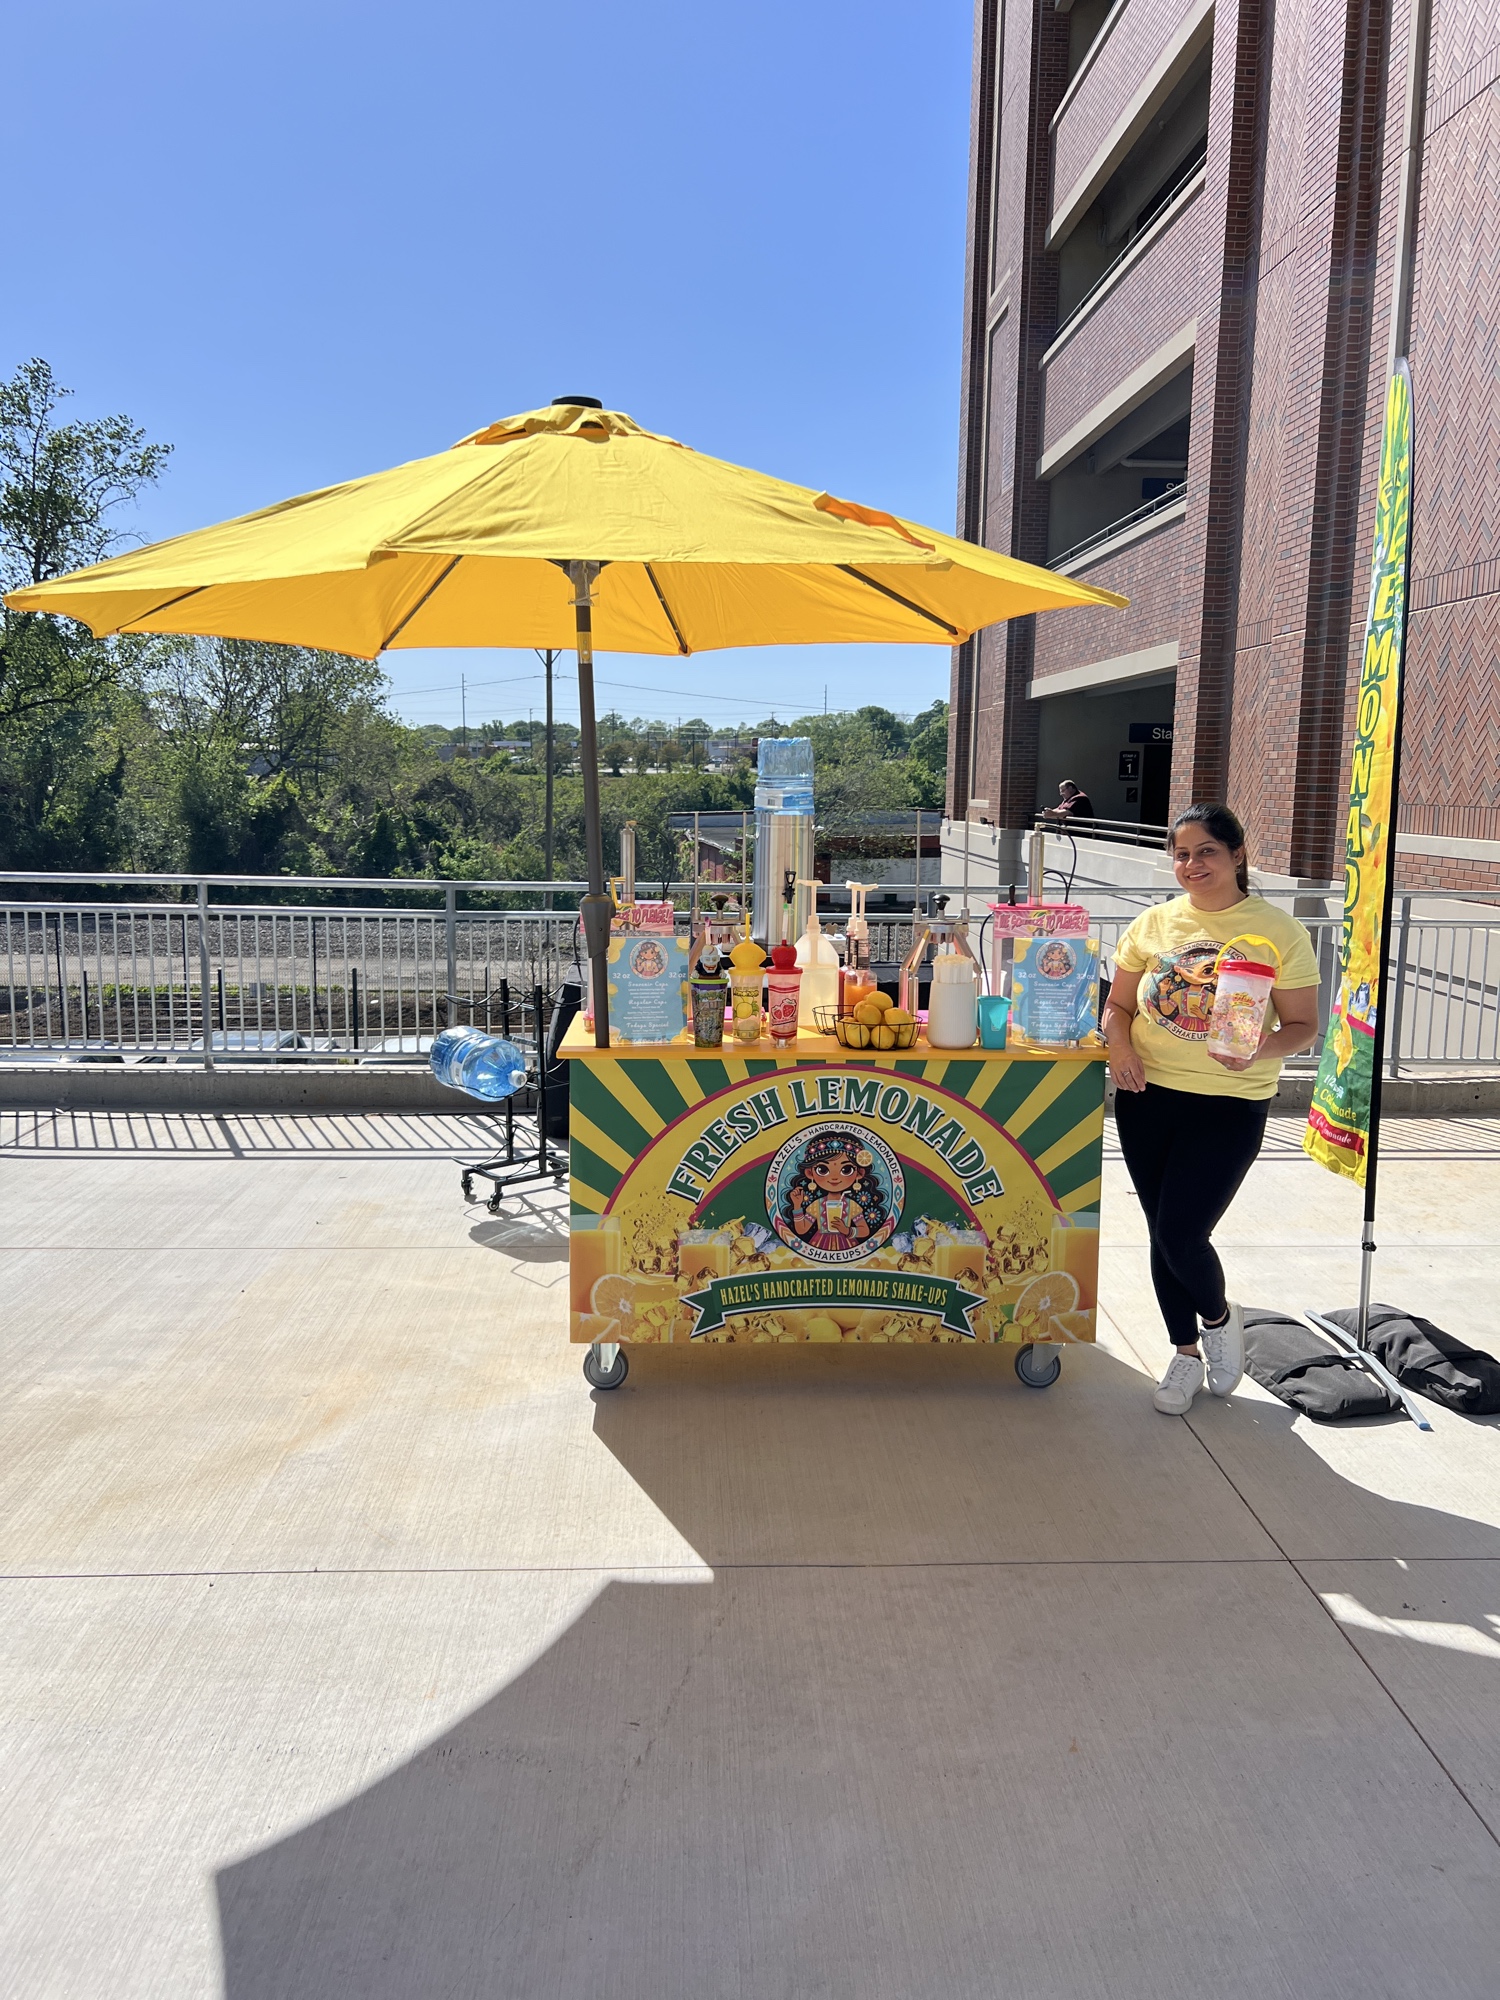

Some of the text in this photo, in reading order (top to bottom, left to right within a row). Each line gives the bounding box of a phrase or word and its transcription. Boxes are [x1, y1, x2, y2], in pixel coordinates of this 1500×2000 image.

[1166, 482, 1186, 494] Sta
[1152, 727, 1172, 739] Sta
[1126, 763, 1131, 773] 1
[631, 908, 641, 924] TO
[642, 907, 670, 924] PLEASE!
[998, 914, 1086, 930] WE SQUEEZE TO PLEASE!
[1182, 942, 1224, 951] HANDCRAFTE
[1017, 971, 1027, 979] 32
[654, 981, 669, 989] Cups
[1171, 1025, 1208, 1040] SHAKEUP
[666, 1076, 1005, 1205] FRESH LEMONADE
[1322, 1128, 1352, 1144] monade
[771, 1124, 900, 1175] HAZEL'S HANDCRAFTED LEMONADE
[808, 1248, 861, 1261] SHAKEUPS
[719, 1278, 948, 1306] HAZEL'S HANDCRAFTED LEMONADE SHAKE-UPS
